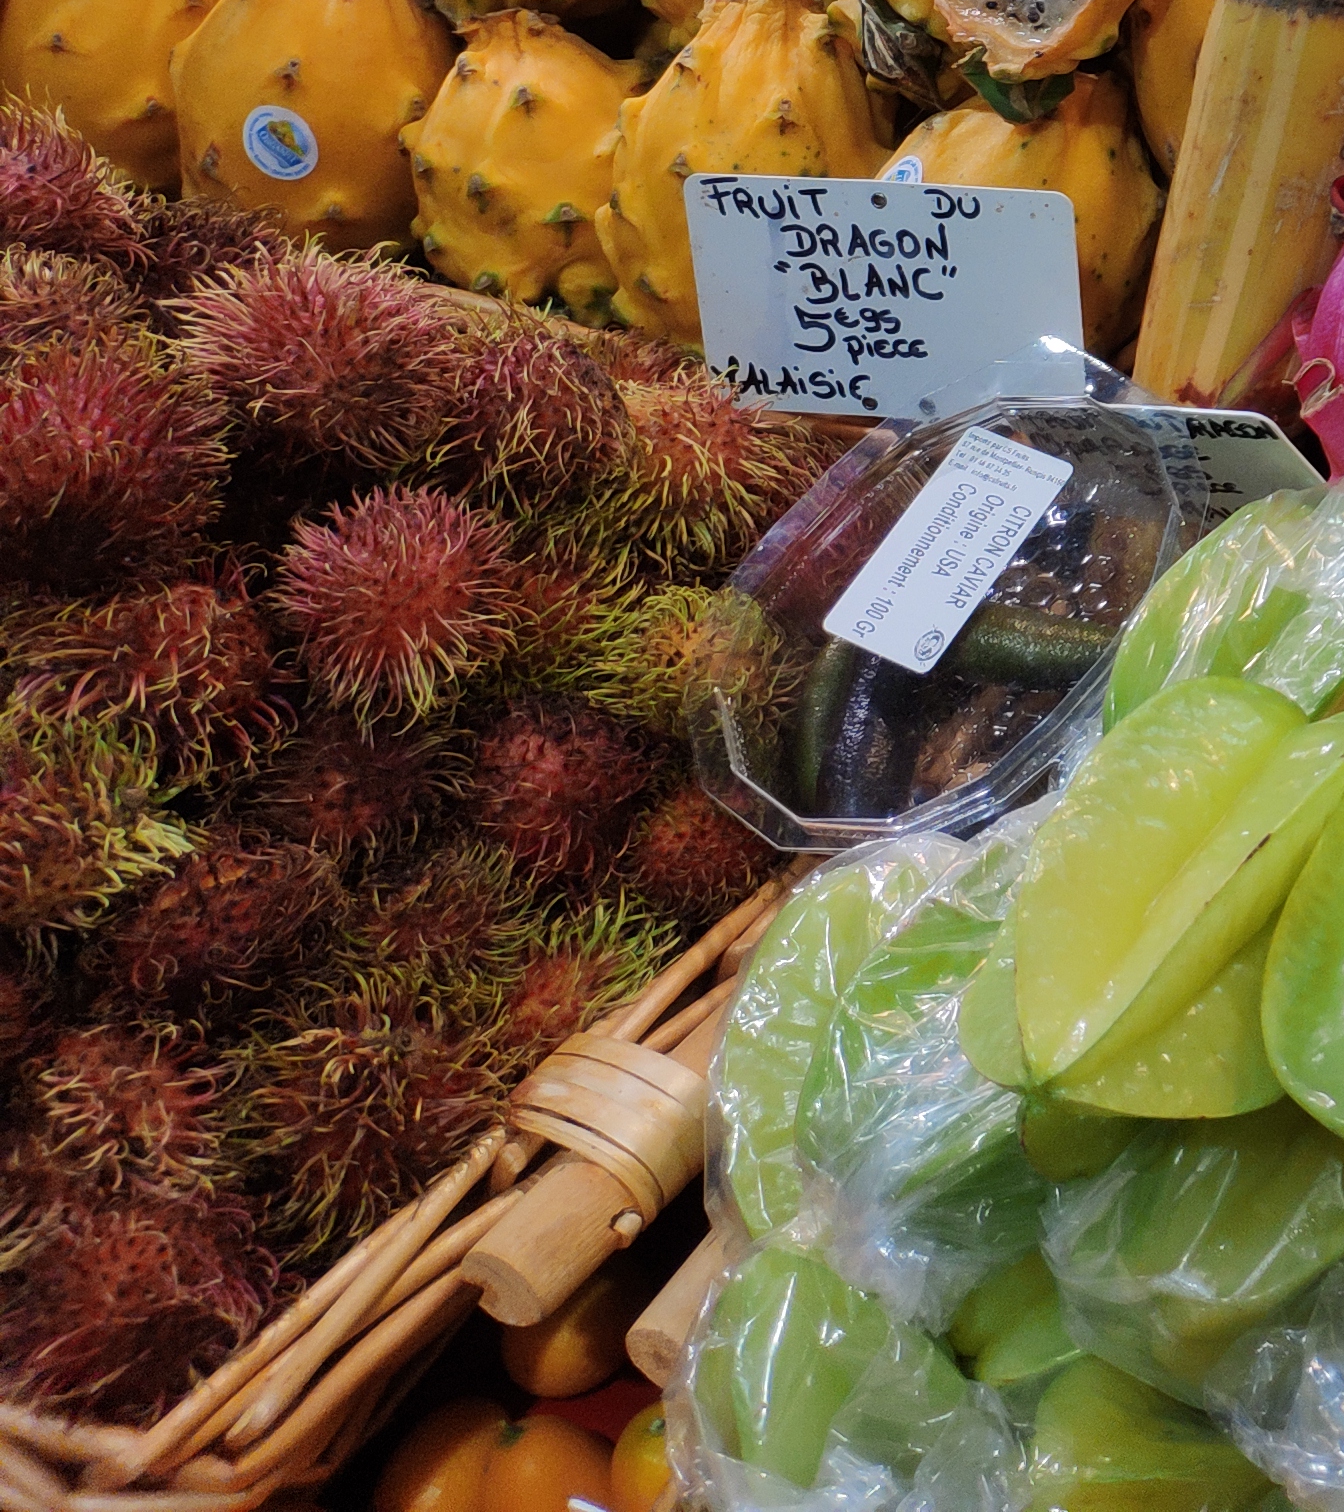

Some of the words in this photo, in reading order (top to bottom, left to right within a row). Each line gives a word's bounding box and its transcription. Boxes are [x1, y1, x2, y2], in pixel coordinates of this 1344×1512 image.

[924, 189, 980, 219] DU
[781, 223, 950, 260] DRAGON
[959, 494, 1005, 540] Origine
[983, 505, 1032, 558] CITRON
[887, 483, 977, 589] Conditionnement
[931, 548, 966, 577] USA
[945, 557, 995, 609] CAVIAR
[865, 596, 894, 620] 100
[852, 620, 876, 638] Gr
